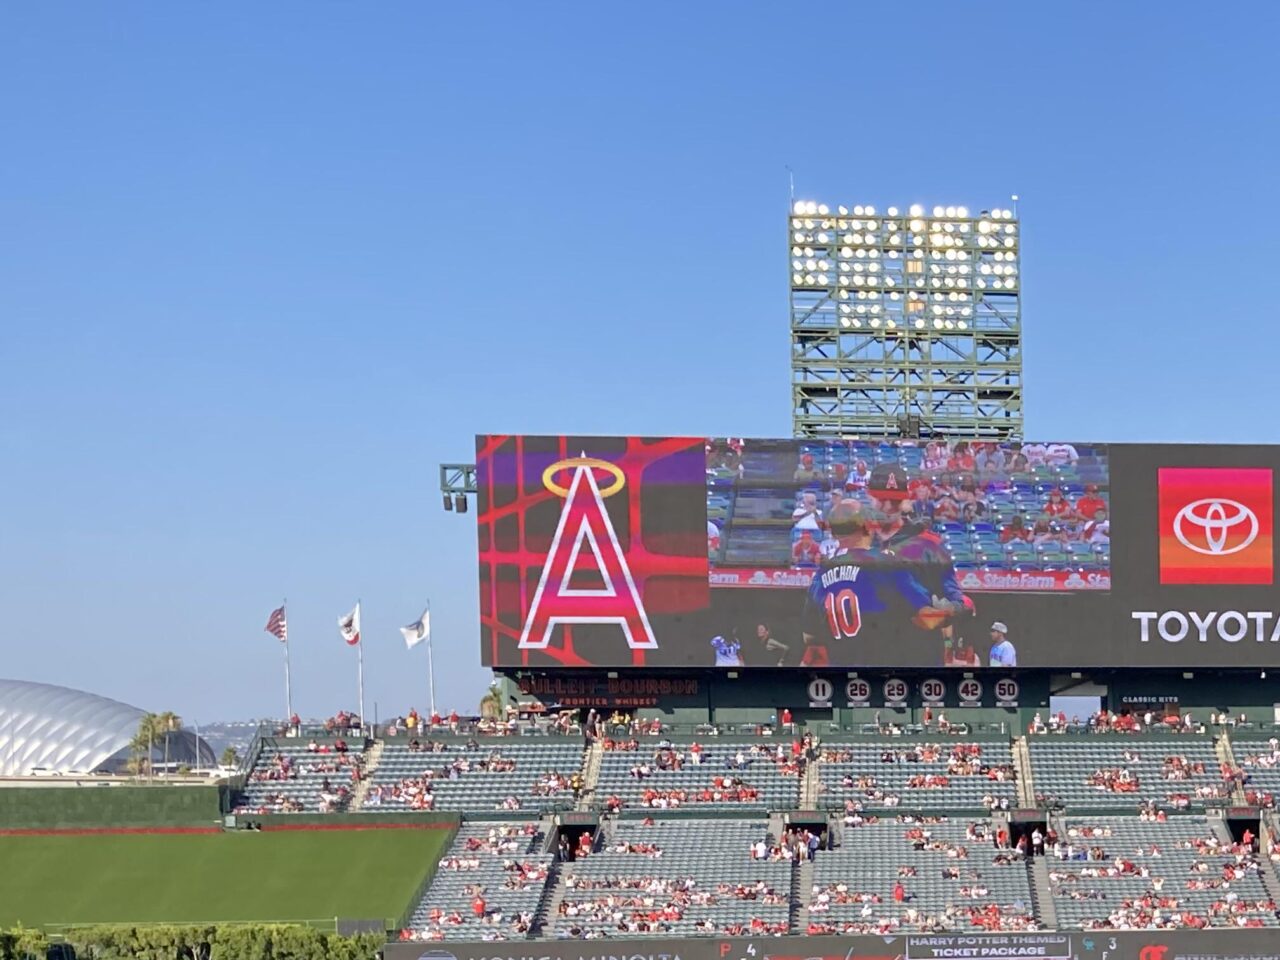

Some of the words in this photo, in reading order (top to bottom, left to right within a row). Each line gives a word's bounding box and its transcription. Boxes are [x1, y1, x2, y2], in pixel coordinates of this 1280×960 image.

[825, 588, 862, 640] 10
[815, 683, 826, 697] 11
[850, 683, 867, 697] 26
[887, 683, 905, 697] 29
[924, 683, 942, 697] 30
[961, 683, 979, 697] 42
[998, 683, 1015, 697] 50
[910, 937, 956, 946] HARRY
[958, 936, 1010, 945] POTTER
[1011, 935, 1066, 944] THEMED
[1109, 937, 1117, 950] 3
[747, 943, 756, 957] 4
[931, 948, 979, 957] TICKET
[981, 946, 1046, 956] PACKAGE
[1102, 951, 1109, 960] F
